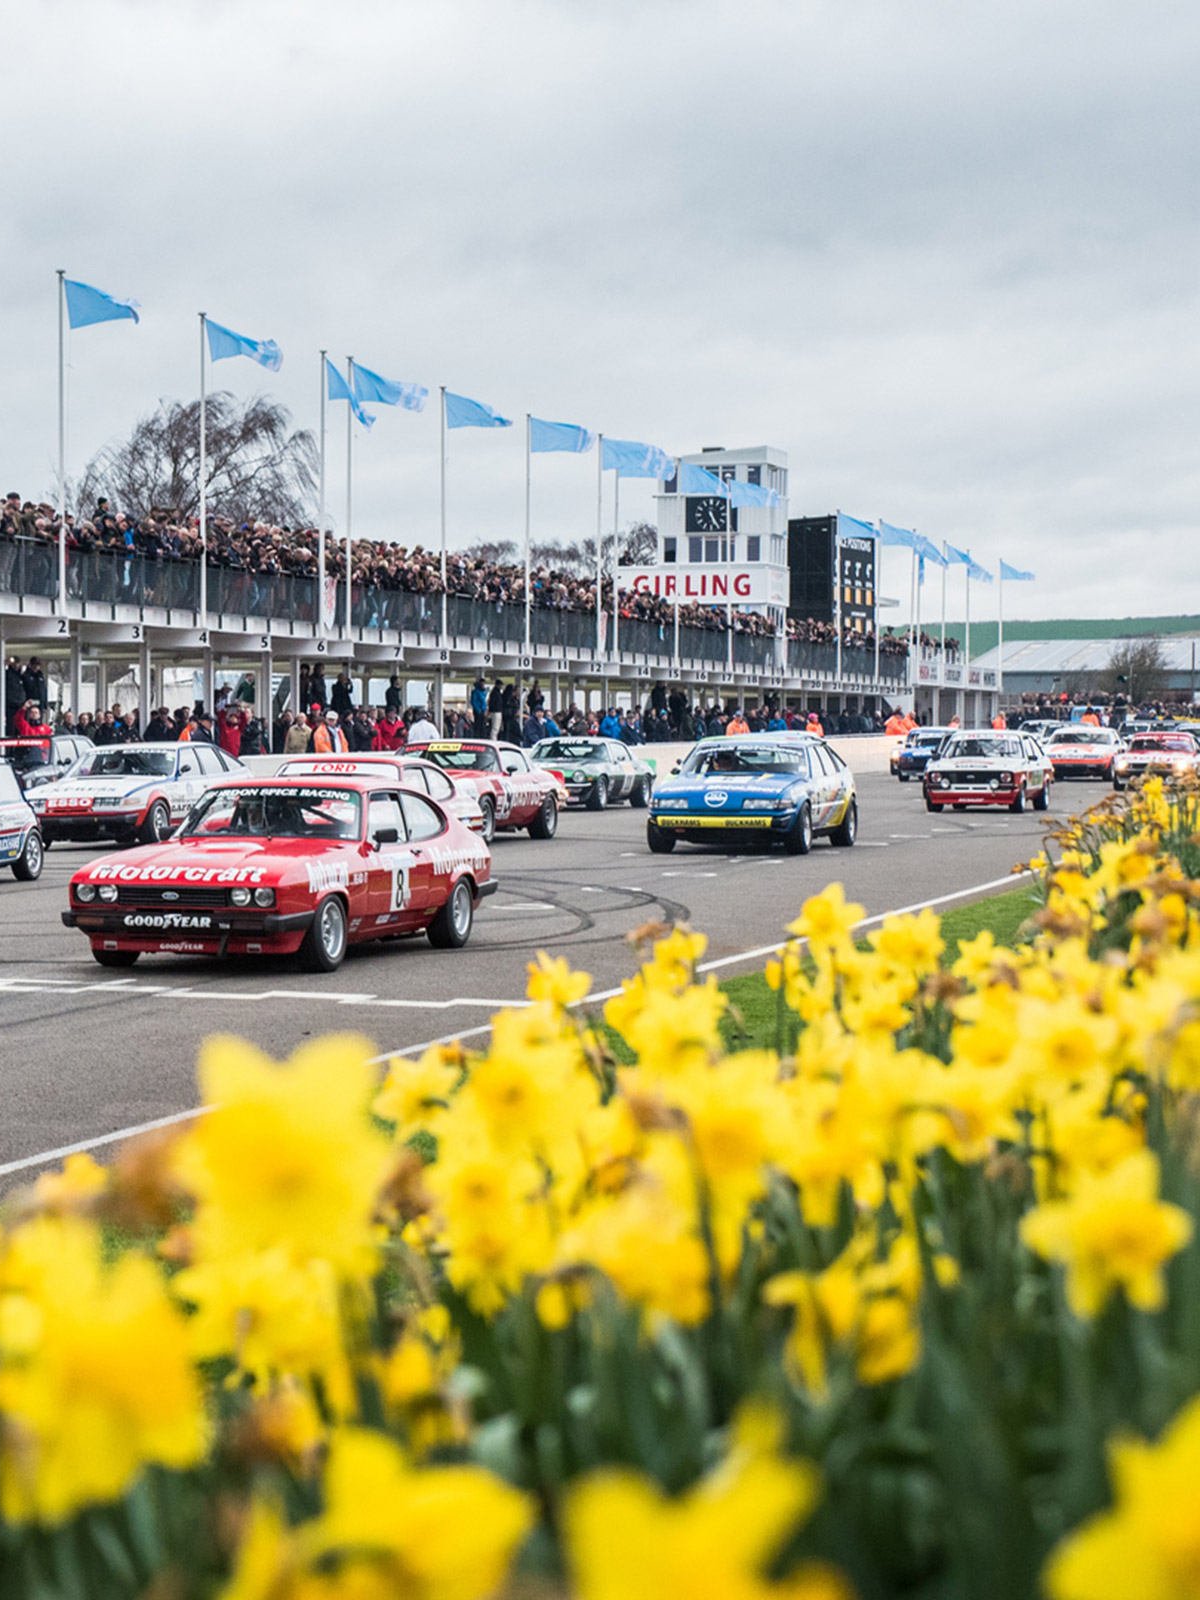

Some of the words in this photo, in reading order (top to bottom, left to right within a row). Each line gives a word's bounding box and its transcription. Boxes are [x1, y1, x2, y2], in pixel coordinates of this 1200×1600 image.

[634, 574, 750, 596] GIRLING
[58, 620, 67, 633] 2
[132, 625, 140, 638] 3
[199, 631, 207, 643] 4
[261, 637, 268, 648] 5
[317, 640, 325, 652] 6
[394, 646, 400, 657] 7
[440, 650, 447, 661] 8
[484, 654, 491, 665] 9
[518, 658, 530, 667] 10
[558, 661, 567, 669] 11
[591, 663, 602, 672] 12
[638, 667, 649, 676] 14
[669, 669, 679, 678] 15
[696, 672, 706, 680] 16
[722, 673, 732, 682] 17
[748, 675, 758, 684] 18
[771, 677, 781, 685] 19
[811, 680, 821, 688] 20
[833, 682, 842, 690] 21
[869, 685, 879, 693] 23
[312, 763, 357, 772] FORD
[260, 788, 298, 796] SPICE
[300, 789, 350, 801] RACING
[47, 799, 91, 808] ESSO
[661, 817, 702, 826] DUCKHAMS
[725, 818, 767, 826] DUCKHAMS
[89, 864, 267, 883] Motorcraft
[396, 869, 404, 908] 8
[123, 914, 212, 929] GOODYEAR
